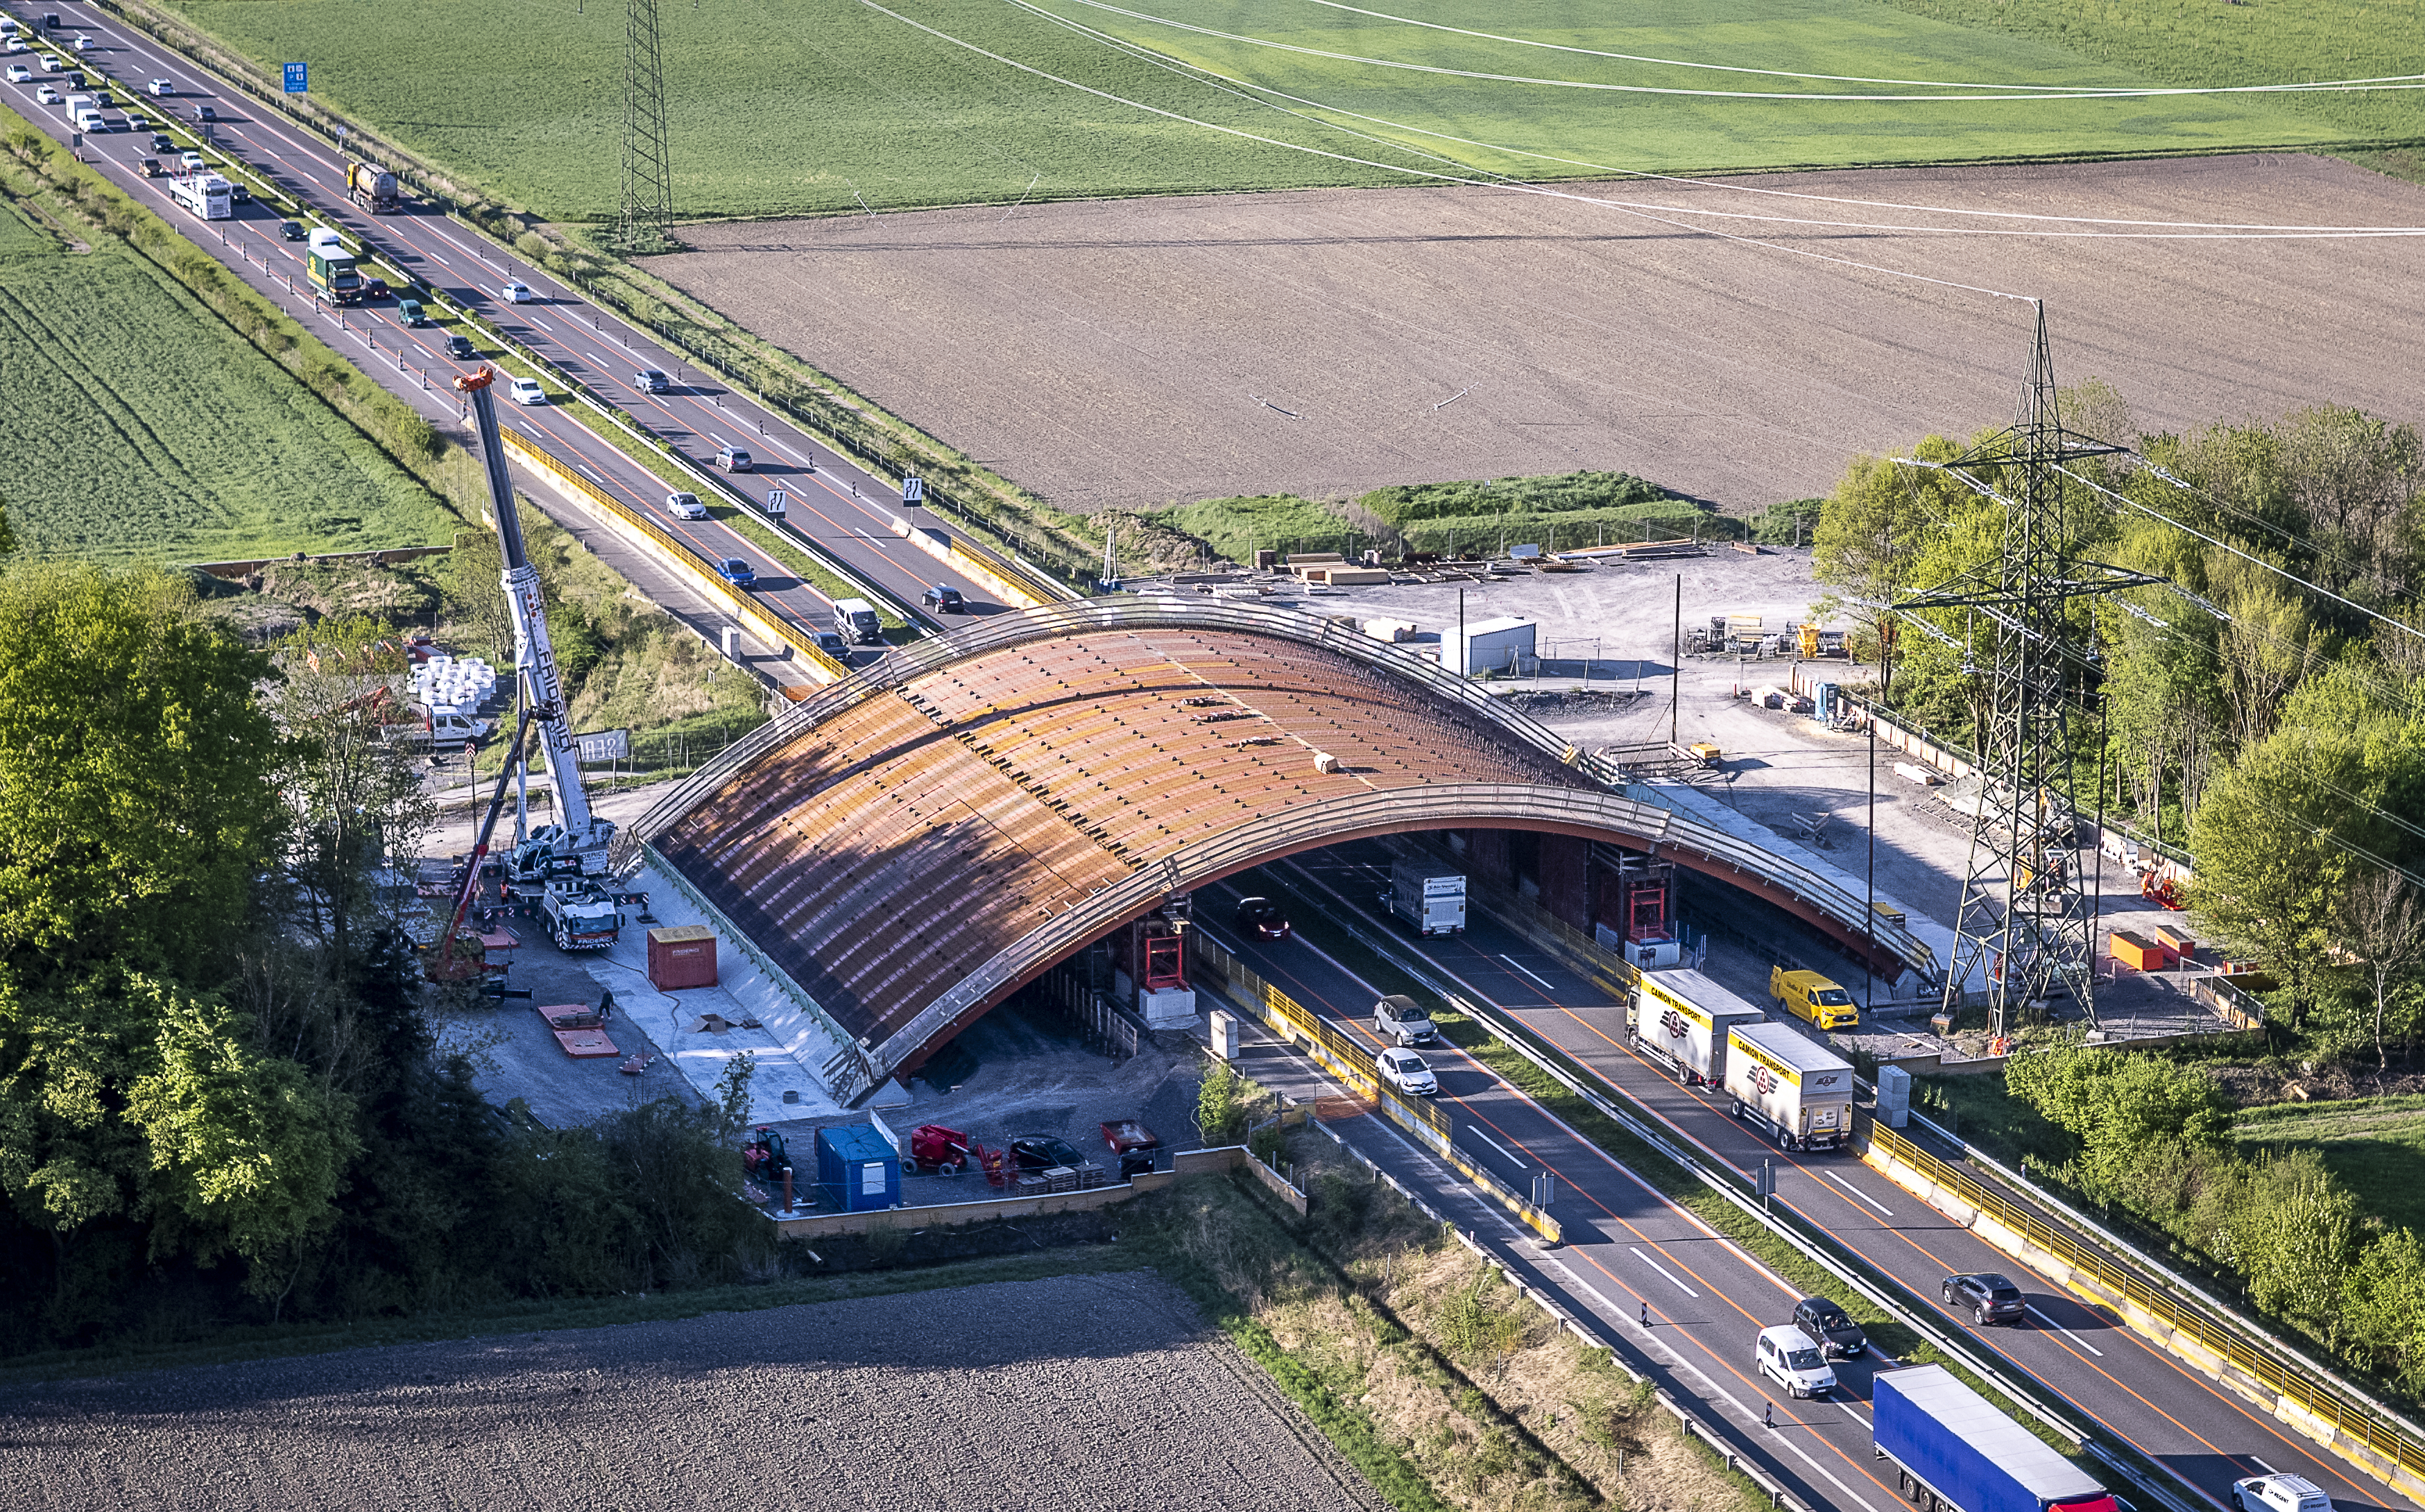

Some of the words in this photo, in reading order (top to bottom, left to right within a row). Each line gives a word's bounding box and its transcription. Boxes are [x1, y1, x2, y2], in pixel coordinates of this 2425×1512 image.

[539, 651, 571, 753] FRIDERICI
[1652, 987, 1671, 1004] CAMION
[1672, 999, 1701, 1022] TRANSPORT
[1738, 1040, 1758, 1060] CAMION
[1760, 1054, 1790, 1079] TRANSPORT
